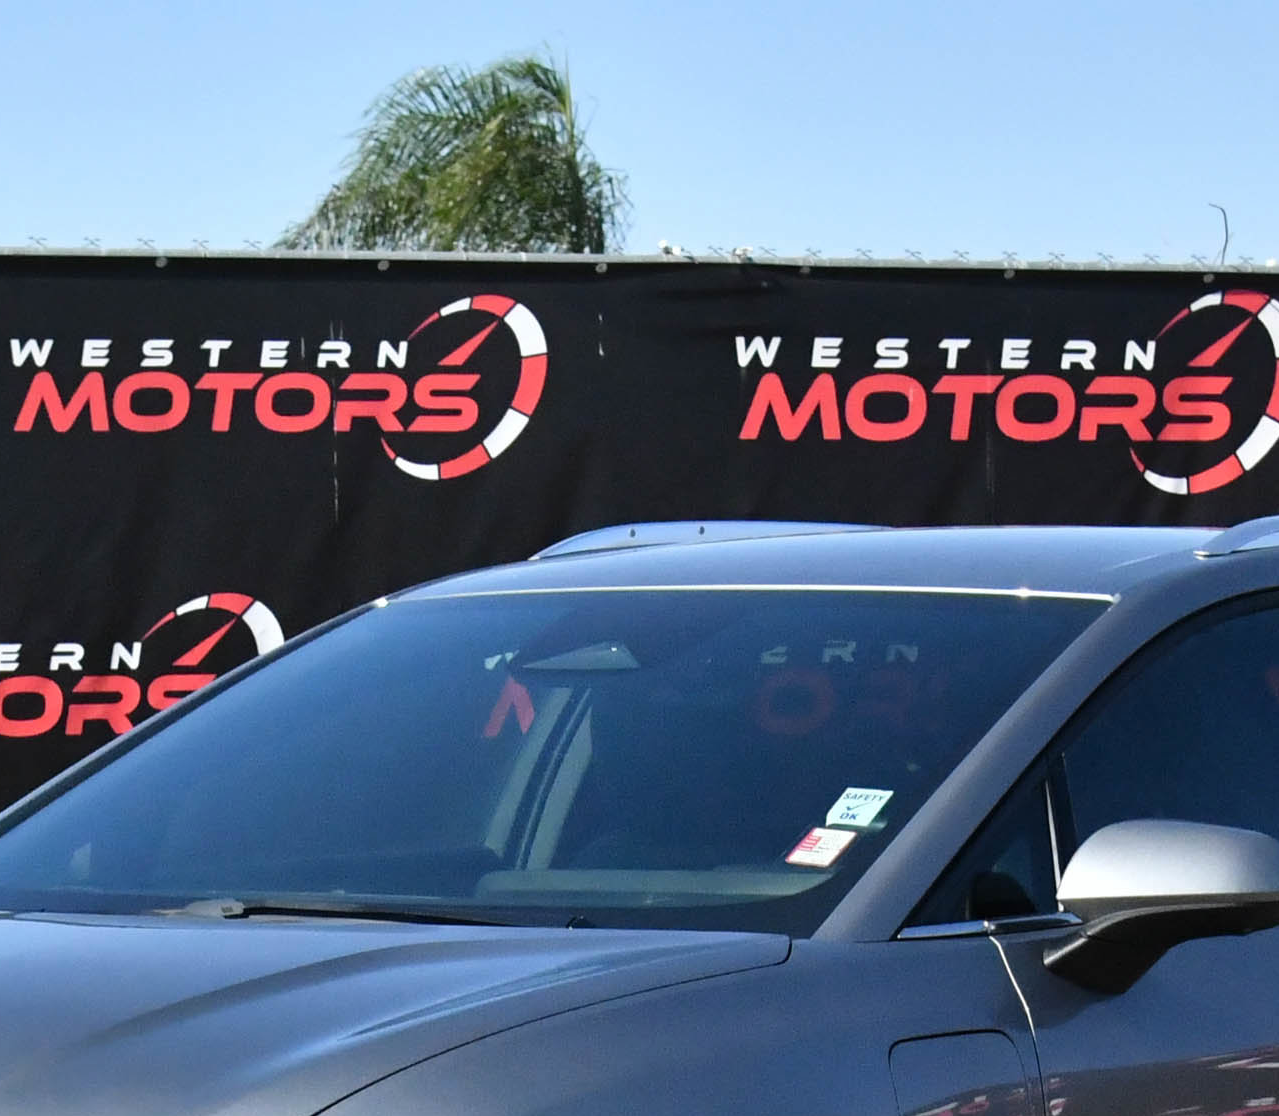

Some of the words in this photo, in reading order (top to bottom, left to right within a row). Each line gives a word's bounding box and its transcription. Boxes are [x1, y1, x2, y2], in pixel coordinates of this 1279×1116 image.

[11, 339, 407, 368] WESTERN
[736, 336, 1155, 370] WESTERN
[14, 372, 481, 432] MOTORS
[739, 373, 1233, 441] MOTORS
[843, 793, 886, 801] SAFETY
[840, 812, 858, 820] OK
